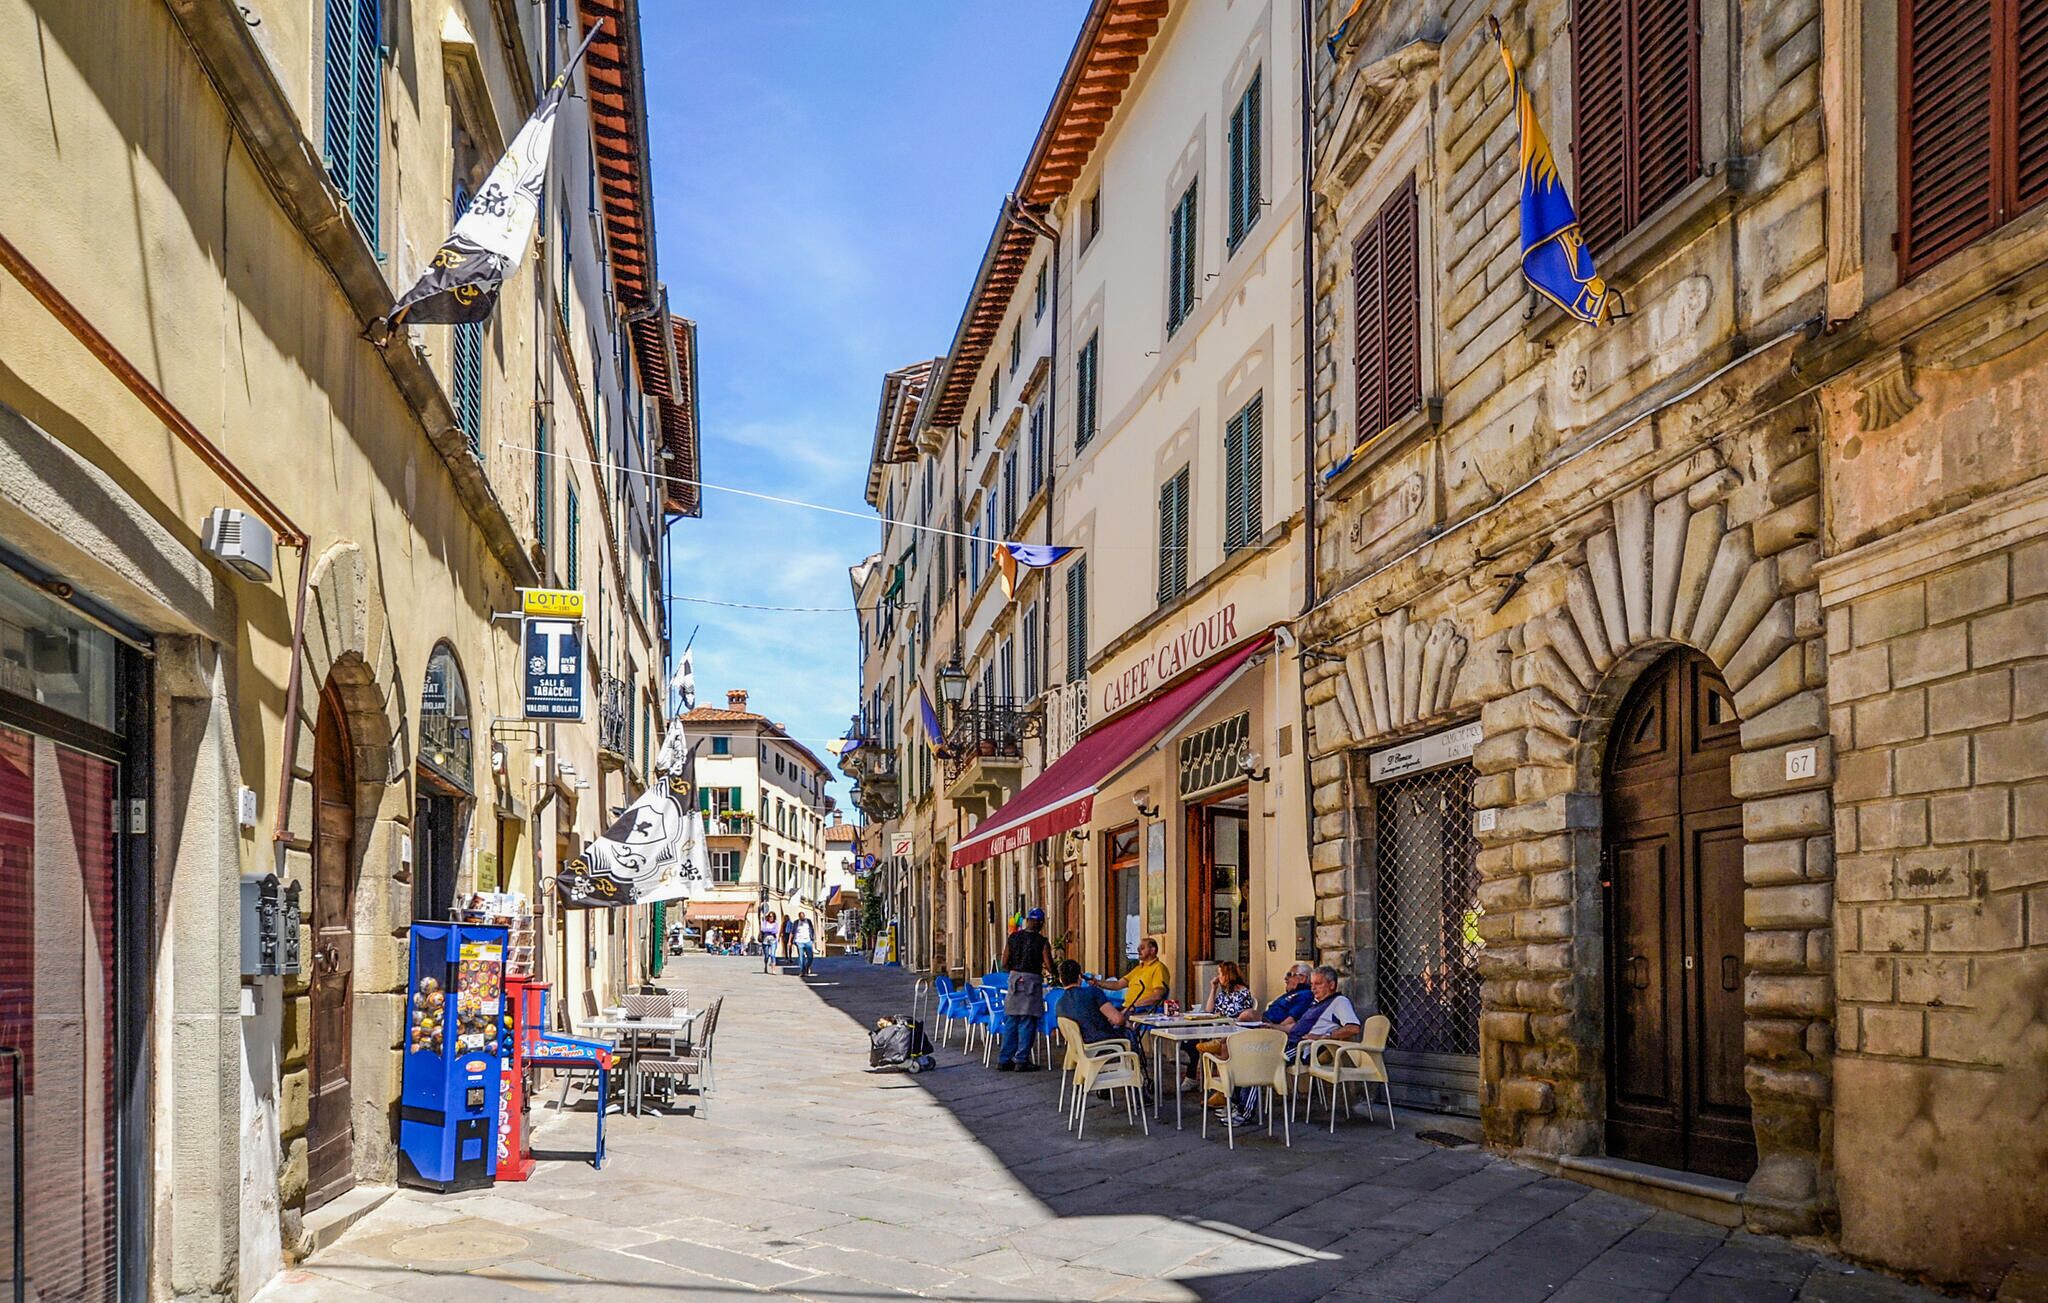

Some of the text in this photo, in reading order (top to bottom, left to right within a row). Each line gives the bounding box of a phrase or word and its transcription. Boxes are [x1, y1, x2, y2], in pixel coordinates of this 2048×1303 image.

[528, 593, 579, 606] LOTTO
[1158, 603, 1238, 679] CAVOUR
[535, 622, 573, 675] T
[540, 679, 557, 687] SALI
[533, 686, 572, 697] TABACCHI
[527, 704, 578, 713] VALORI BOLLATI
[1791, 755, 1808, 773] 67
